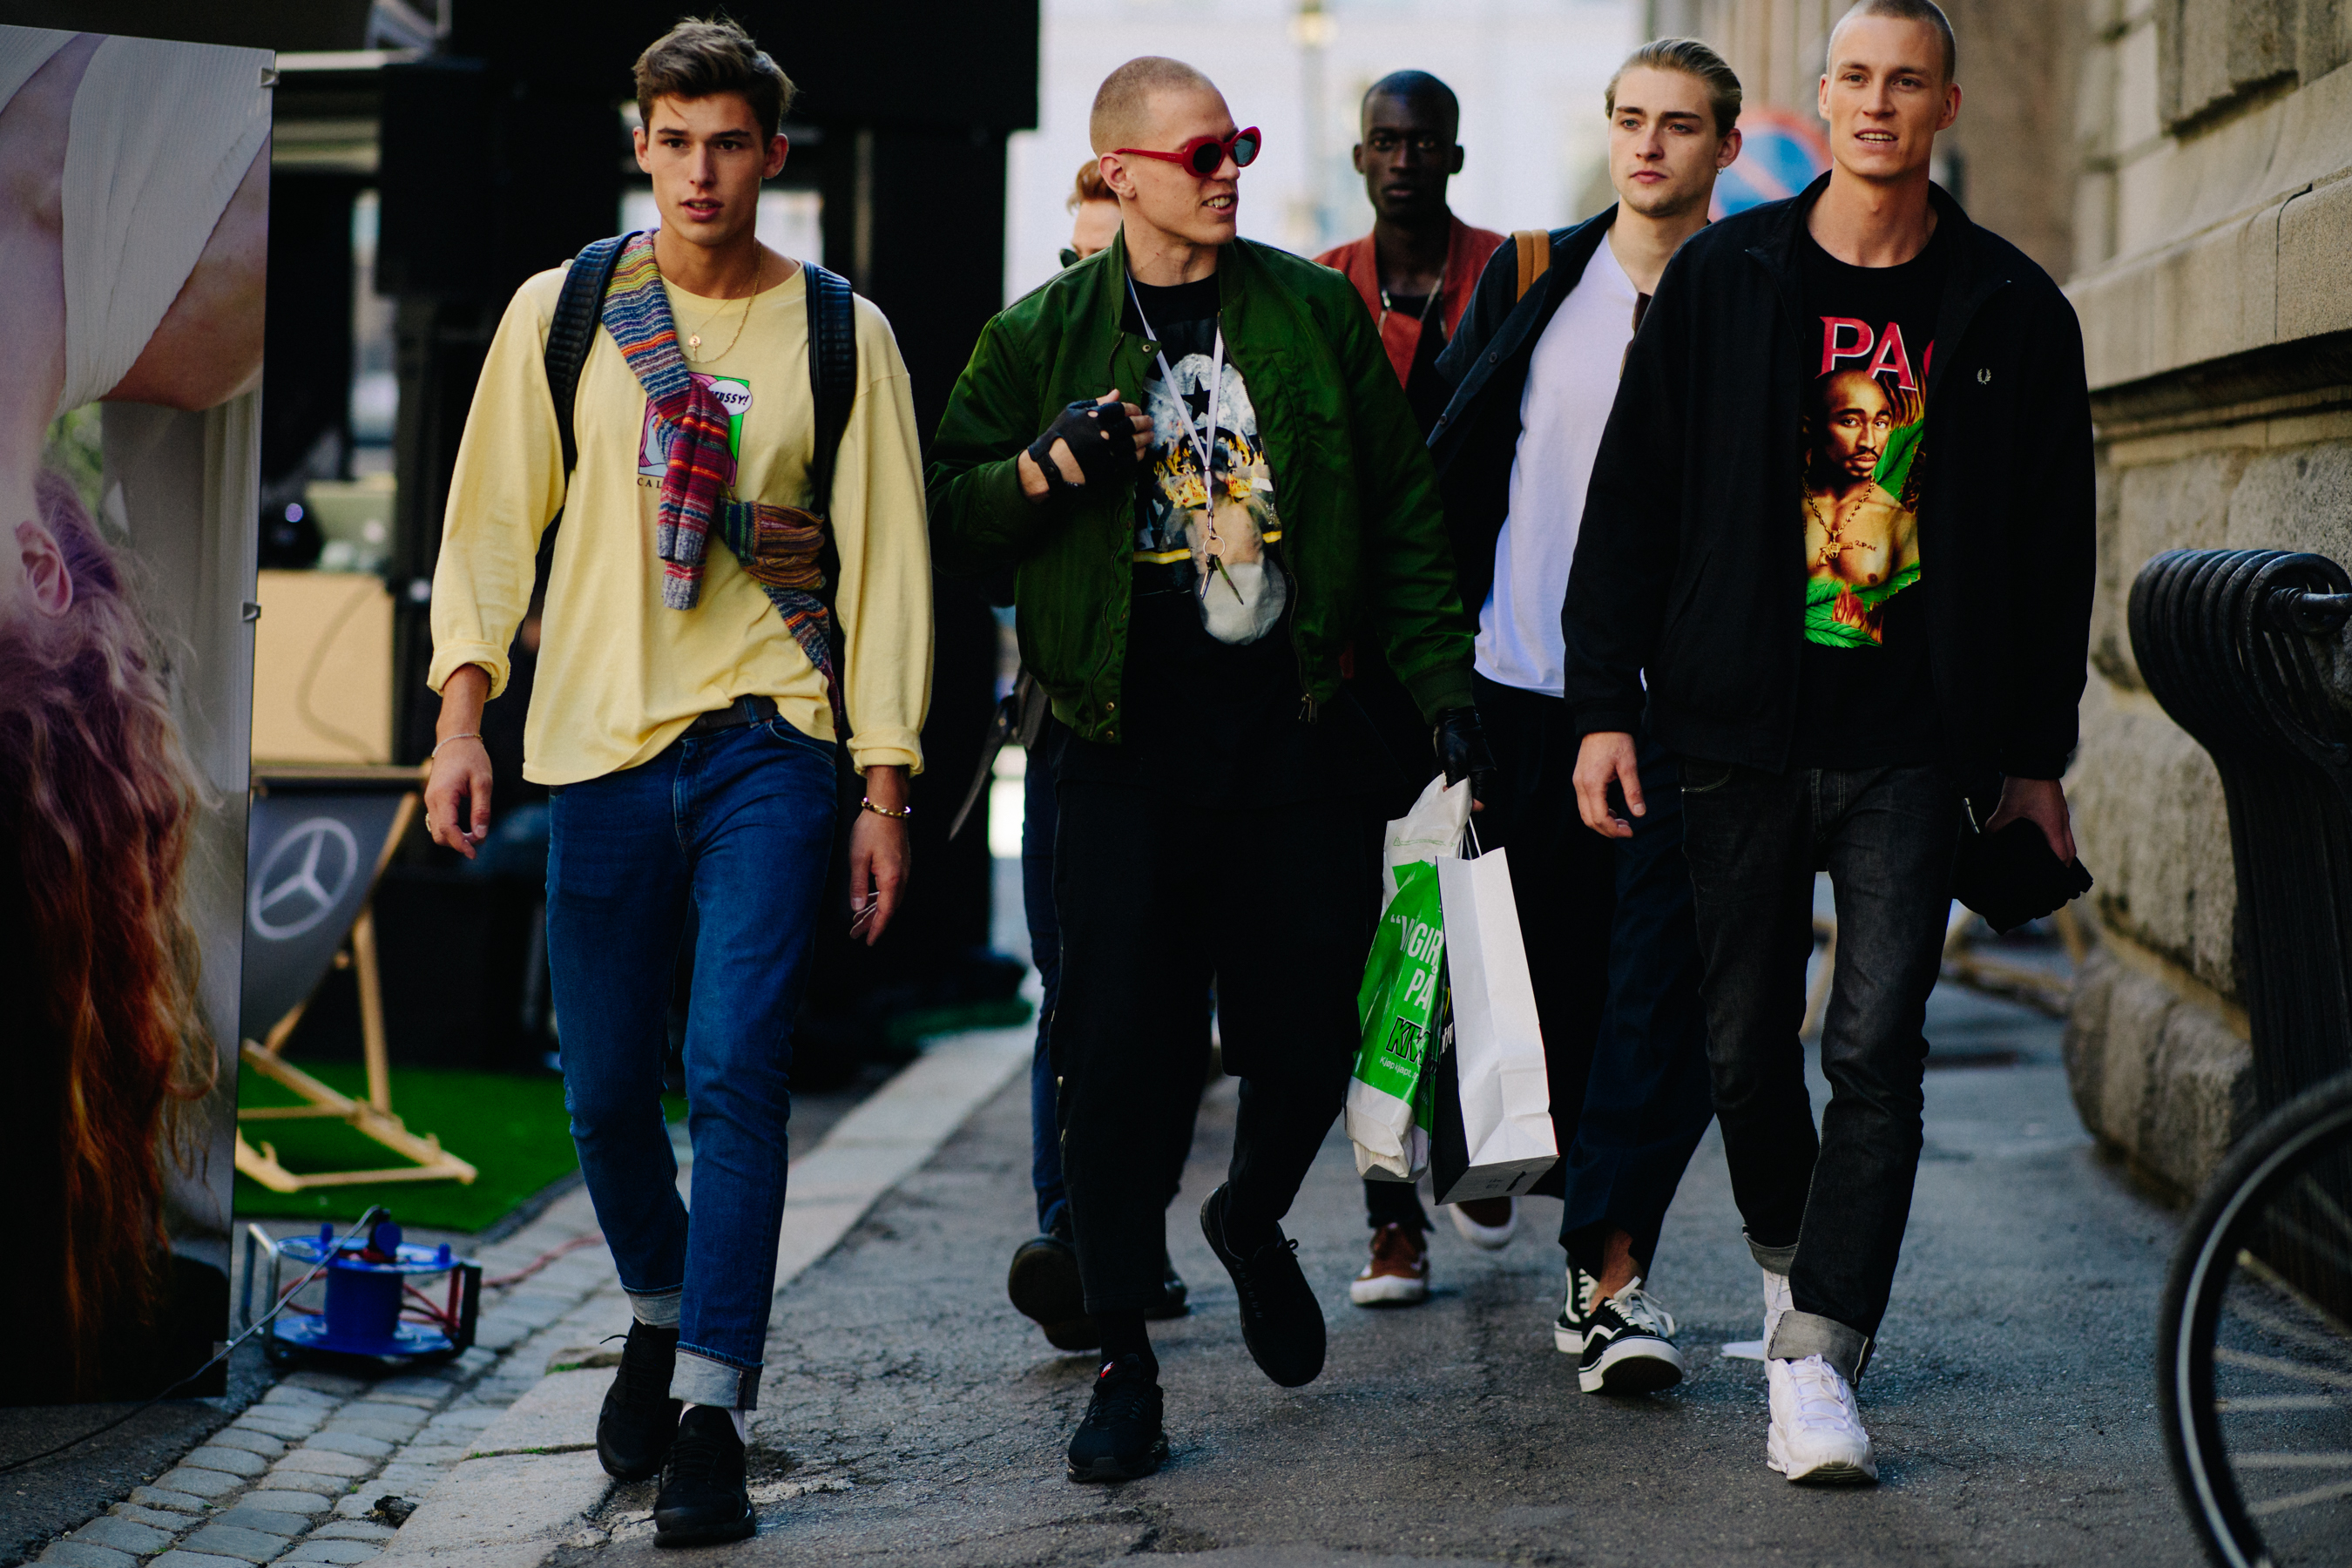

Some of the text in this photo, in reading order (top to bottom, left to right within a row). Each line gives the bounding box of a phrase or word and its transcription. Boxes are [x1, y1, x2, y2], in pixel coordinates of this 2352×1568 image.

[637, 477, 662, 489] CAL
[1407, 923, 1445, 967] GIR
[1403, 966, 1439, 1010] PÅ
